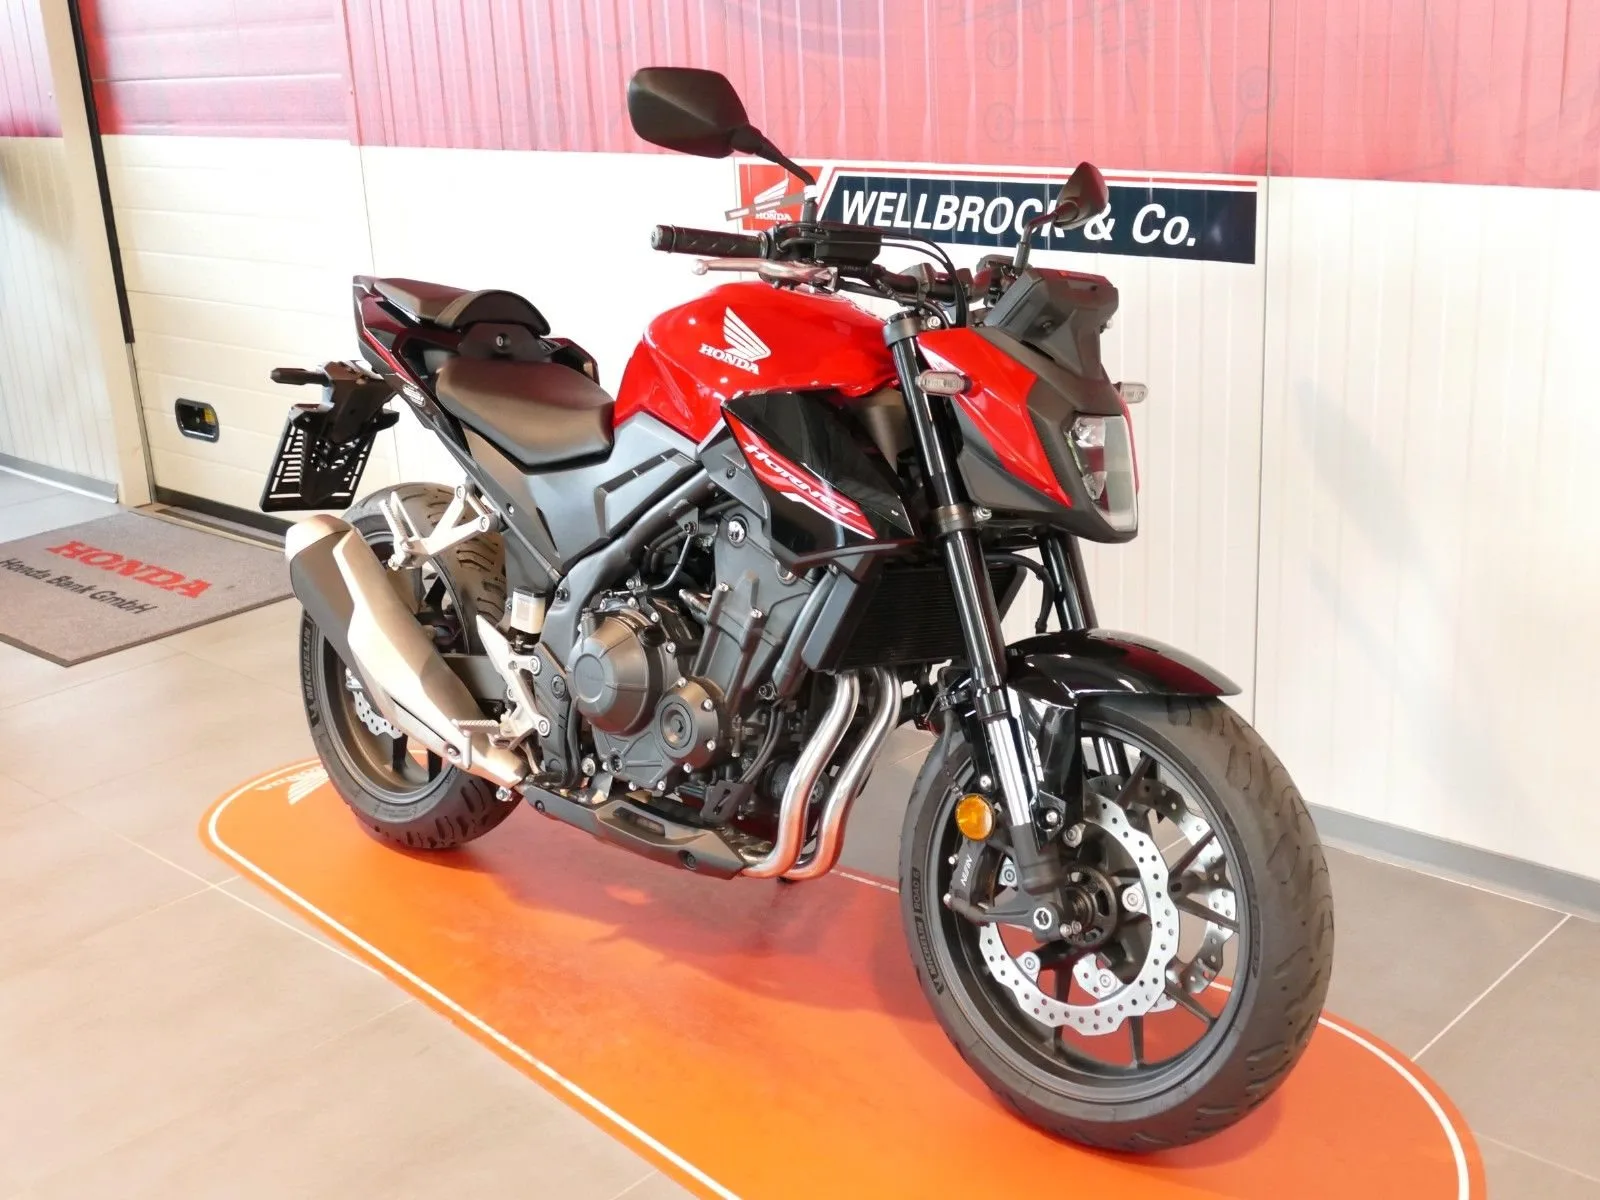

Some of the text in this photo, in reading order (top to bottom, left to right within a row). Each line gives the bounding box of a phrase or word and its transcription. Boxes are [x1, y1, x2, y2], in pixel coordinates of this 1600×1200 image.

[755, 211, 792, 222] HONDA
[1083, 203, 1116, 241] &
[1132, 203, 1195, 247] Co.
[699, 343, 759, 375] HONDA
[0, 558, 157, 614] Honda Bank GmbH
[45, 541, 212, 598] HONDA
[303, 627, 315, 701] MICHELIN
[913, 881, 922, 912] ROAD
[916, 921, 939, 976] MICHELIN
